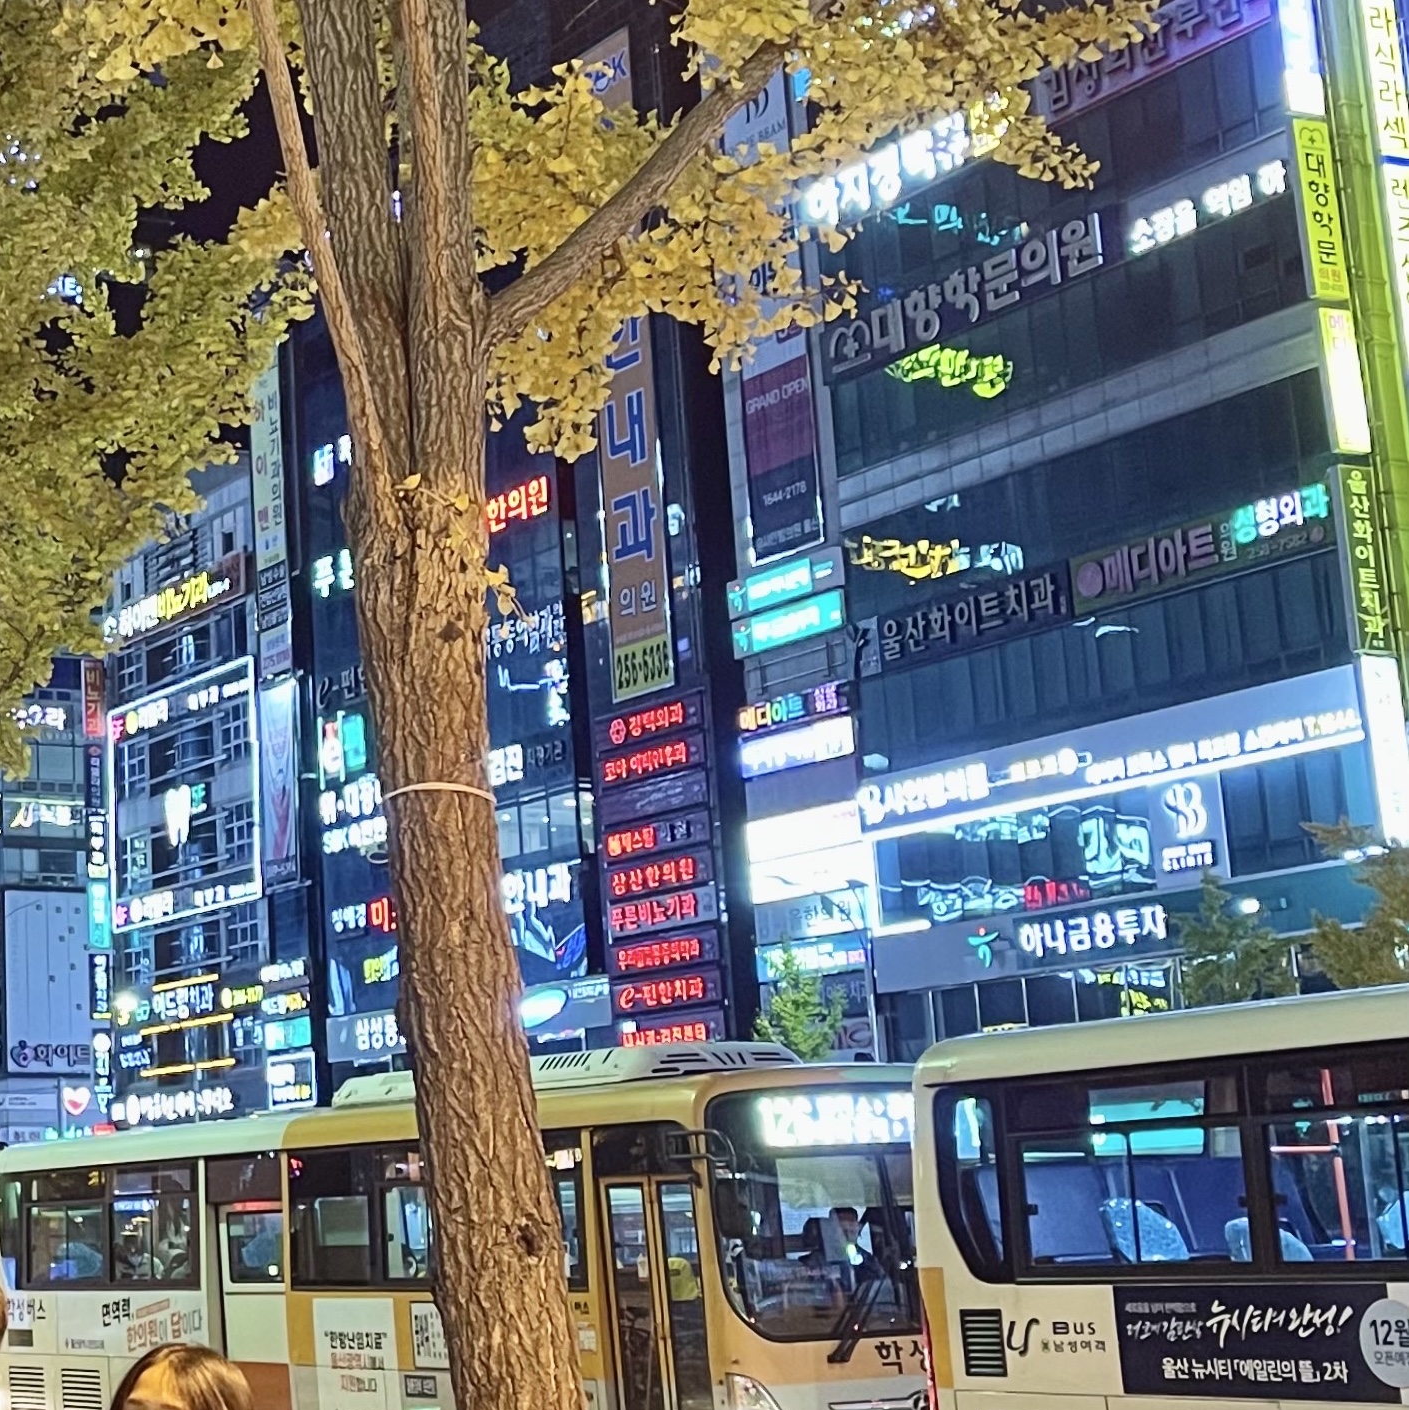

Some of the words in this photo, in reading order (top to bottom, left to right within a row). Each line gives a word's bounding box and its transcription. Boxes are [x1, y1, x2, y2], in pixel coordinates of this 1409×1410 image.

[745, 388, 780, 415] GRAND
[781, 375, 809, 400] OPEN
[486, 475, 548, 533] 한의원
[1102, 523, 1219, 594] 메디아트
[1233, 483, 1330, 544] 성형외과
[1347, 469, 1386, 640] 울산화이트치과
[619, 579, 657, 617] 의원
[881, 573, 1055, 661] 울산화이트치과
[739, 694, 805, 731] 메디아트
[610, 892, 697, 933] 푸른비뇨기과
[1019, 904, 1168, 958] 하나금융투자
[356, 1013, 407, 1051] 삼성증
[1052, 1320, 1096, 1336] Bus
[1369, 1318, 1409, 1349] 12월
[1162, 1356, 1189, 1380] 울산
[1191, 1358, 1233, 1380] 뉴시티
[1323, 1361, 1349, 1384] 2차
